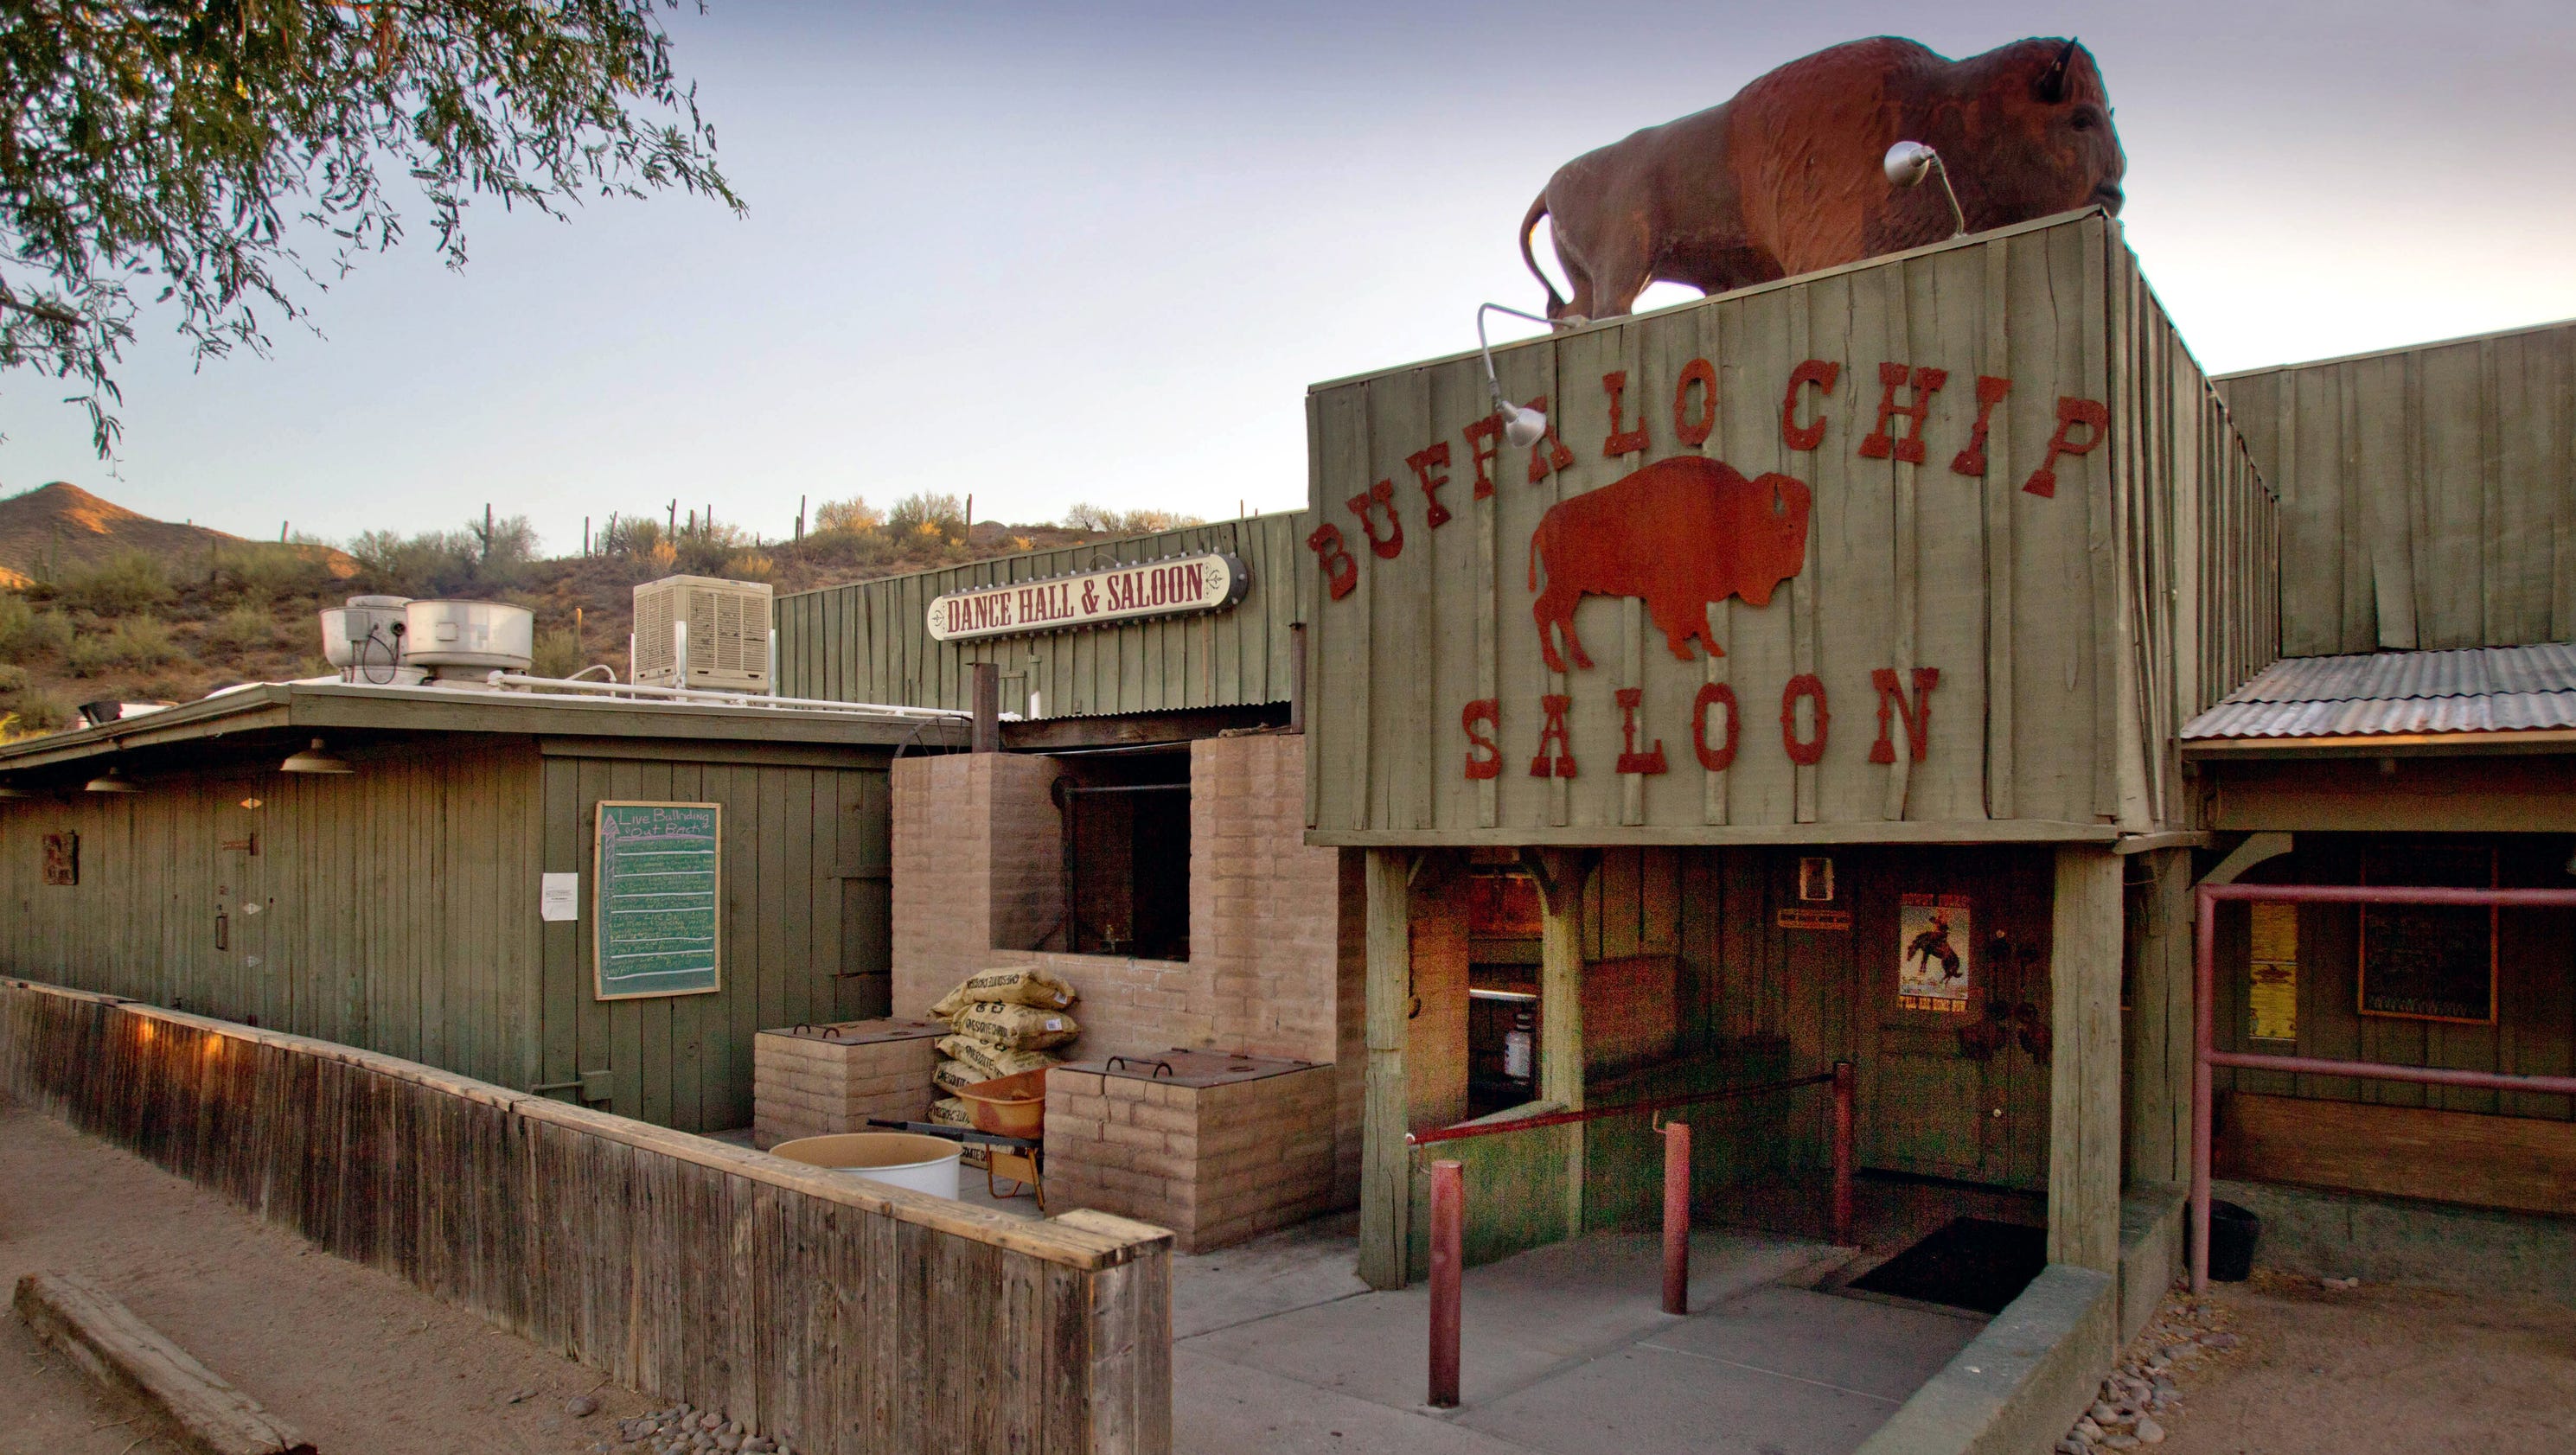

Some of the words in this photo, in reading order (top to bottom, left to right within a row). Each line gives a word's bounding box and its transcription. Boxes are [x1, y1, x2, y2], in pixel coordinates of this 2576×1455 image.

[1307, 359, 1717, 600] BUFFALO
[1782, 360, 2108, 499] CHIP
[947, 592, 1012, 634] DANCE
[1018, 583, 1074, 623] HALL
[1082, 578, 1100, 615] &
[1107, 563, 1204, 612] SALOON
[1463, 667, 1940, 780] SALOON
